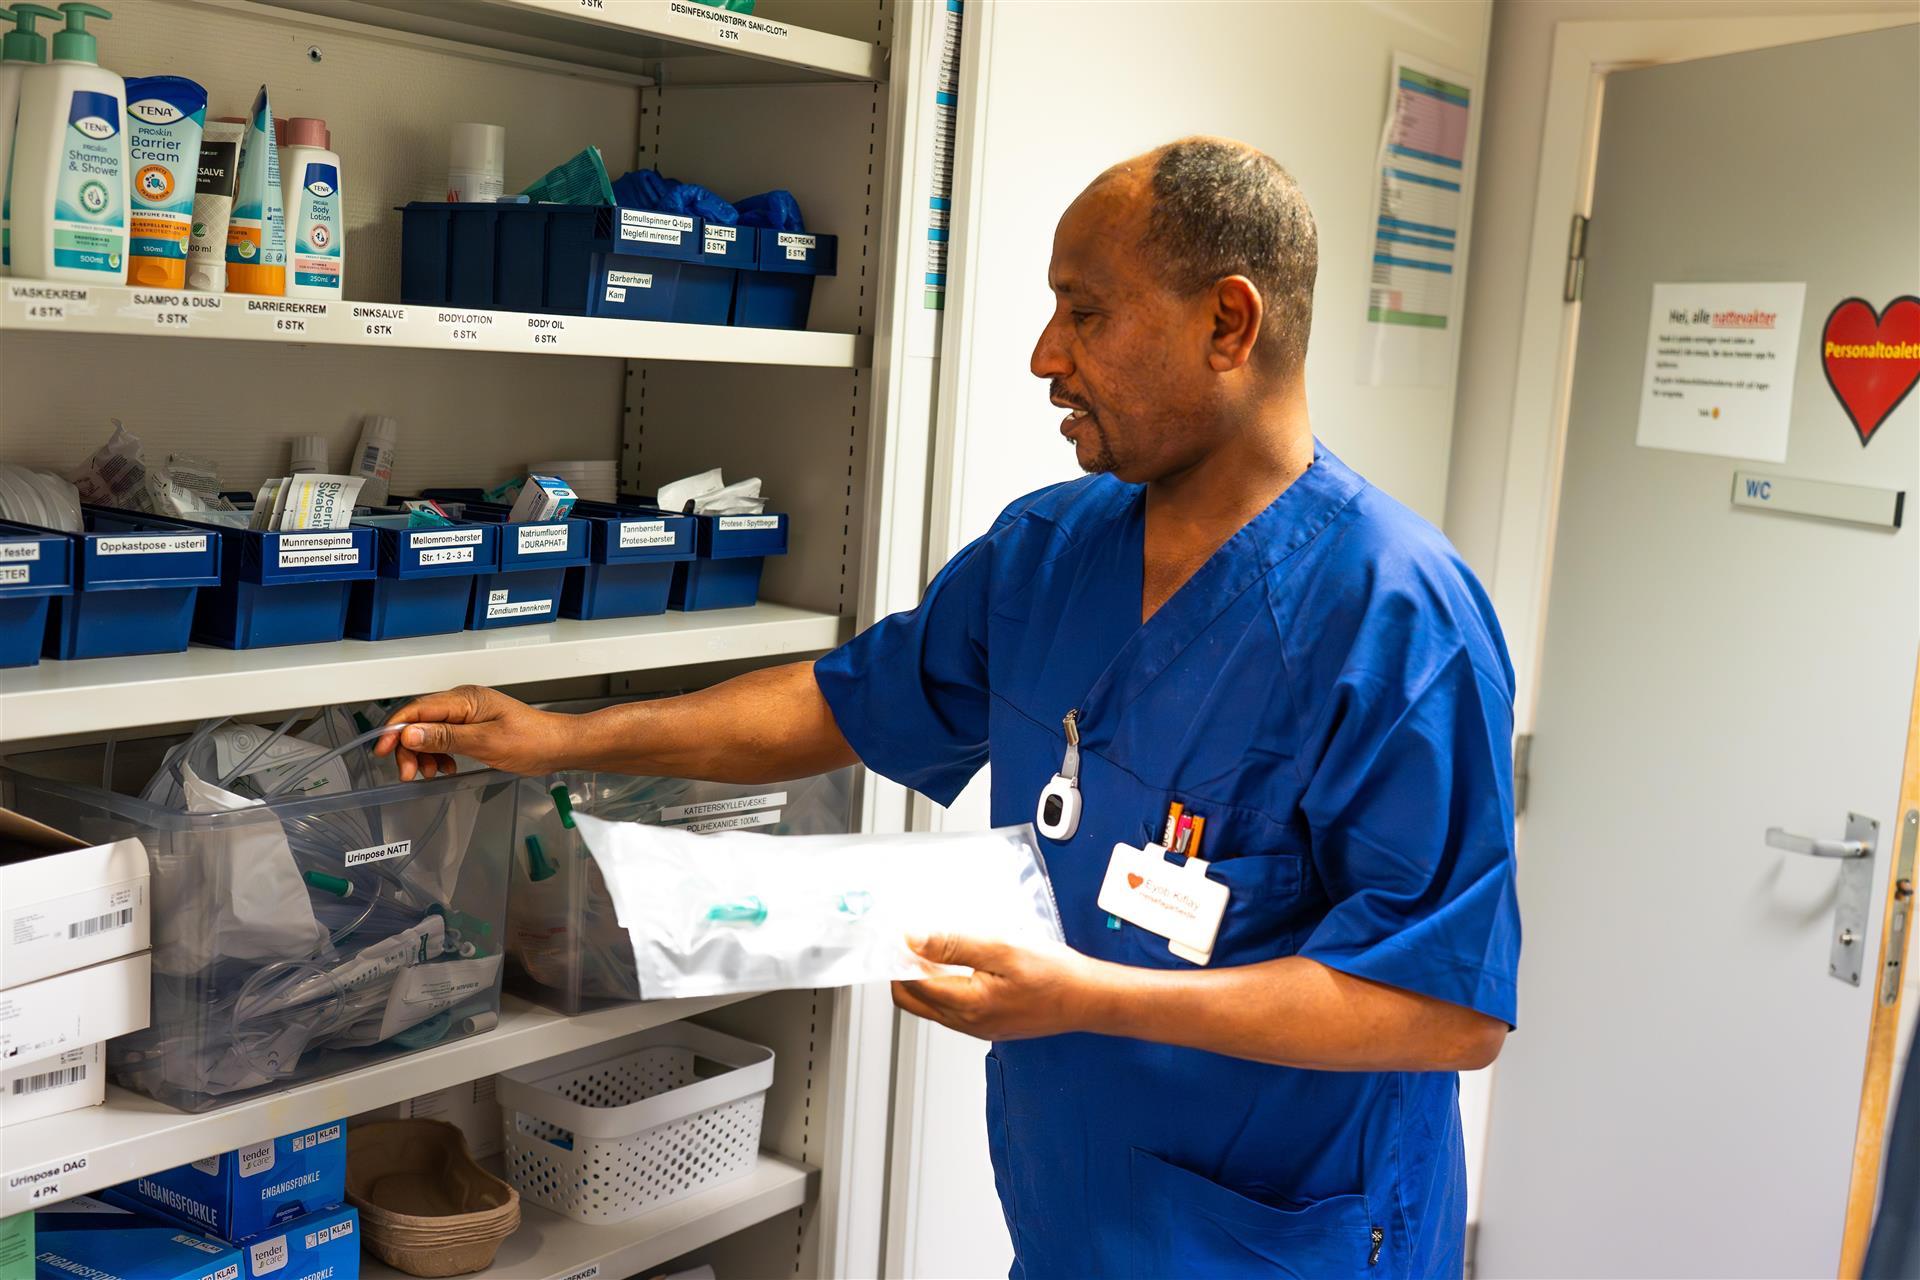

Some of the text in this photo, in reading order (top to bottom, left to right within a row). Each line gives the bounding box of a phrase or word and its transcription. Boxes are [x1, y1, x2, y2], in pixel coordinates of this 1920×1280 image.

[588, 0, 602, 8] STK
[671, 3, 788, 37] DESINFEKSJONSTØRK SANI-CLOTH
[720, 29, 738, 40] 2 STK
[138, 105, 172, 117] TENA
[84, 122, 108, 133] TENA
[138, 128, 172, 136] PROskin
[131, 136, 181, 150] Barrier
[69, 150, 118, 166] Shampoo
[131, 148, 180, 162] Cream
[69, 161, 118, 176] & Shower
[312, 205, 330, 214] Body
[310, 213, 330, 222] Lotion
[623, 212, 692, 230] Bomullspinner Q-tips
[622, 228, 679, 242] Neglefil m/renser
[714, 229, 735, 238] HETTE
[707, 242, 725, 251] 5 STK
[780, 236, 815, 246] SKO-TREKK
[610, 274, 651, 285] Barberhøvel
[12, 286, 87, 300] VASKEKREM
[608, 290, 624, 299] Kam
[134, 294, 220, 308] SJAMPO & DUSJ
[248, 300, 326, 314] BARRIEREKREM
[30, 307, 63, 317] 4 STK
[354, 308, 404, 320] SINKSALVE
[1692, 309, 1710, 324] alle
[158, 314, 188, 324] 5 STK
[438, 313, 492, 324] BODYLOTION
[528, 318, 564, 330] BODY OIL
[277, 320, 304, 331] 6 STK
[366, 325, 392, 335] 6 STK
[454, 330, 477, 340] 6 STK
[535, 334, 556, 344] 6 STK
[1746, 480, 1772, 501] WC
[624, 525, 664, 533] Tannbørster
[747, 519, 777, 528] Spyttbeger
[520, 528, 567, 538] Natriumfluorid
[100, 541, 166, 553] Oppkastpose
[174, 538, 205, 550] usteril
[282, 537, 351, 548] Munnrensepinne
[412, 534, 482, 545] Mellomrom-børster
[622, 536, 673, 545] Protese-børster
[5, 547, 36, 558] fester
[422, 554, 434, 562] Str.
[446, 552, 452, 560] 2
[456, 552, 462, 560] 3
[467, 550, 472, 558] 4
[281, 552, 358, 566] Munnpensel sitron
[489, 604, 550, 616] Zendium tannkrem
[684, 797, 767, 815] KATETERSKYLLEVÆSKE
[686, 816, 761, 832] POLIHEXANIDE 100ML
[348, 844, 408, 863] Urinpose NATT
[306, 1128, 338, 1144] 50 KLAR
[243, 1147, 270, 1163] tender
[253, 1156, 270, 1168] care
[10, 1158, 86, 1188] Urinpose DAG
[262, 1170, 320, 1200] ENGANGSFORKLE
[34, 1185, 58, 1198] 4 PK
[138, 1177, 218, 1227] ENGANGSFORKLE
[320, 1222, 351, 1239] 50 KLAR
[255, 1245, 283, 1261] tender
[266, 1254, 282, 1265] care
[216, 1266, 236, 1280] KLAR
